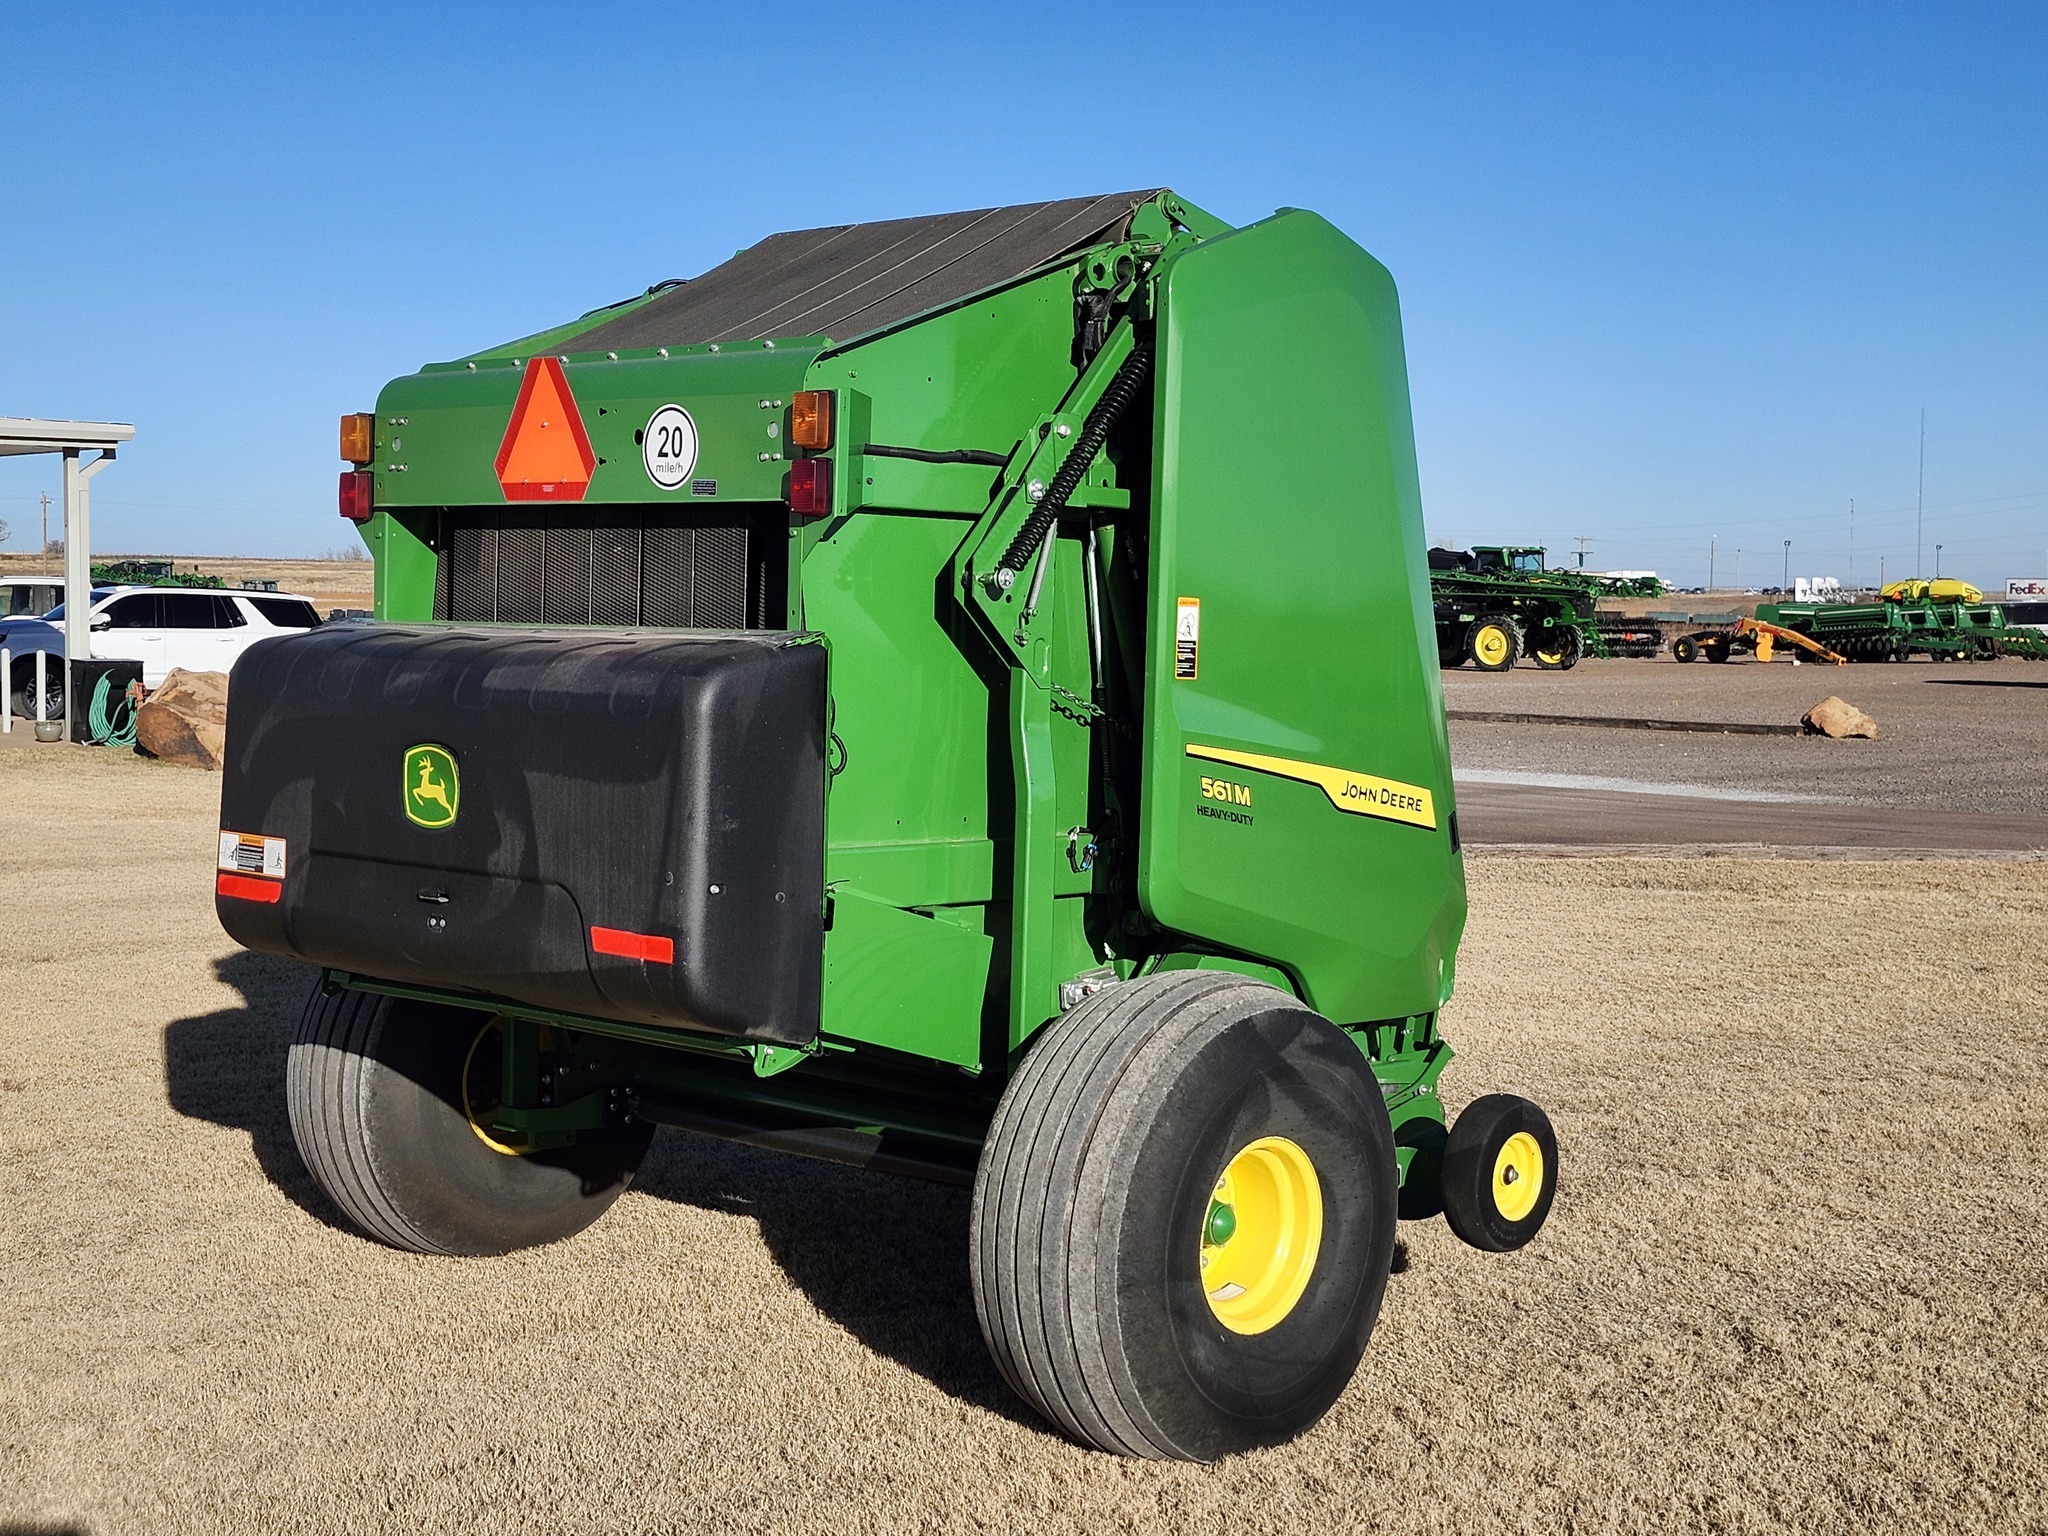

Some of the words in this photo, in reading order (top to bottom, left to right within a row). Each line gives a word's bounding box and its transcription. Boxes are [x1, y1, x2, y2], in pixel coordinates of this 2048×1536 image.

[657, 426, 683, 458] 20
[655, 462, 683, 473] mile/h
[2009, 582, 2046, 595] FedEx
[1341, 780, 1377, 803] JOHN
[1380, 788, 1422, 812] DEERE
[1196, 804, 1254, 826] HEAVY-DUTY
